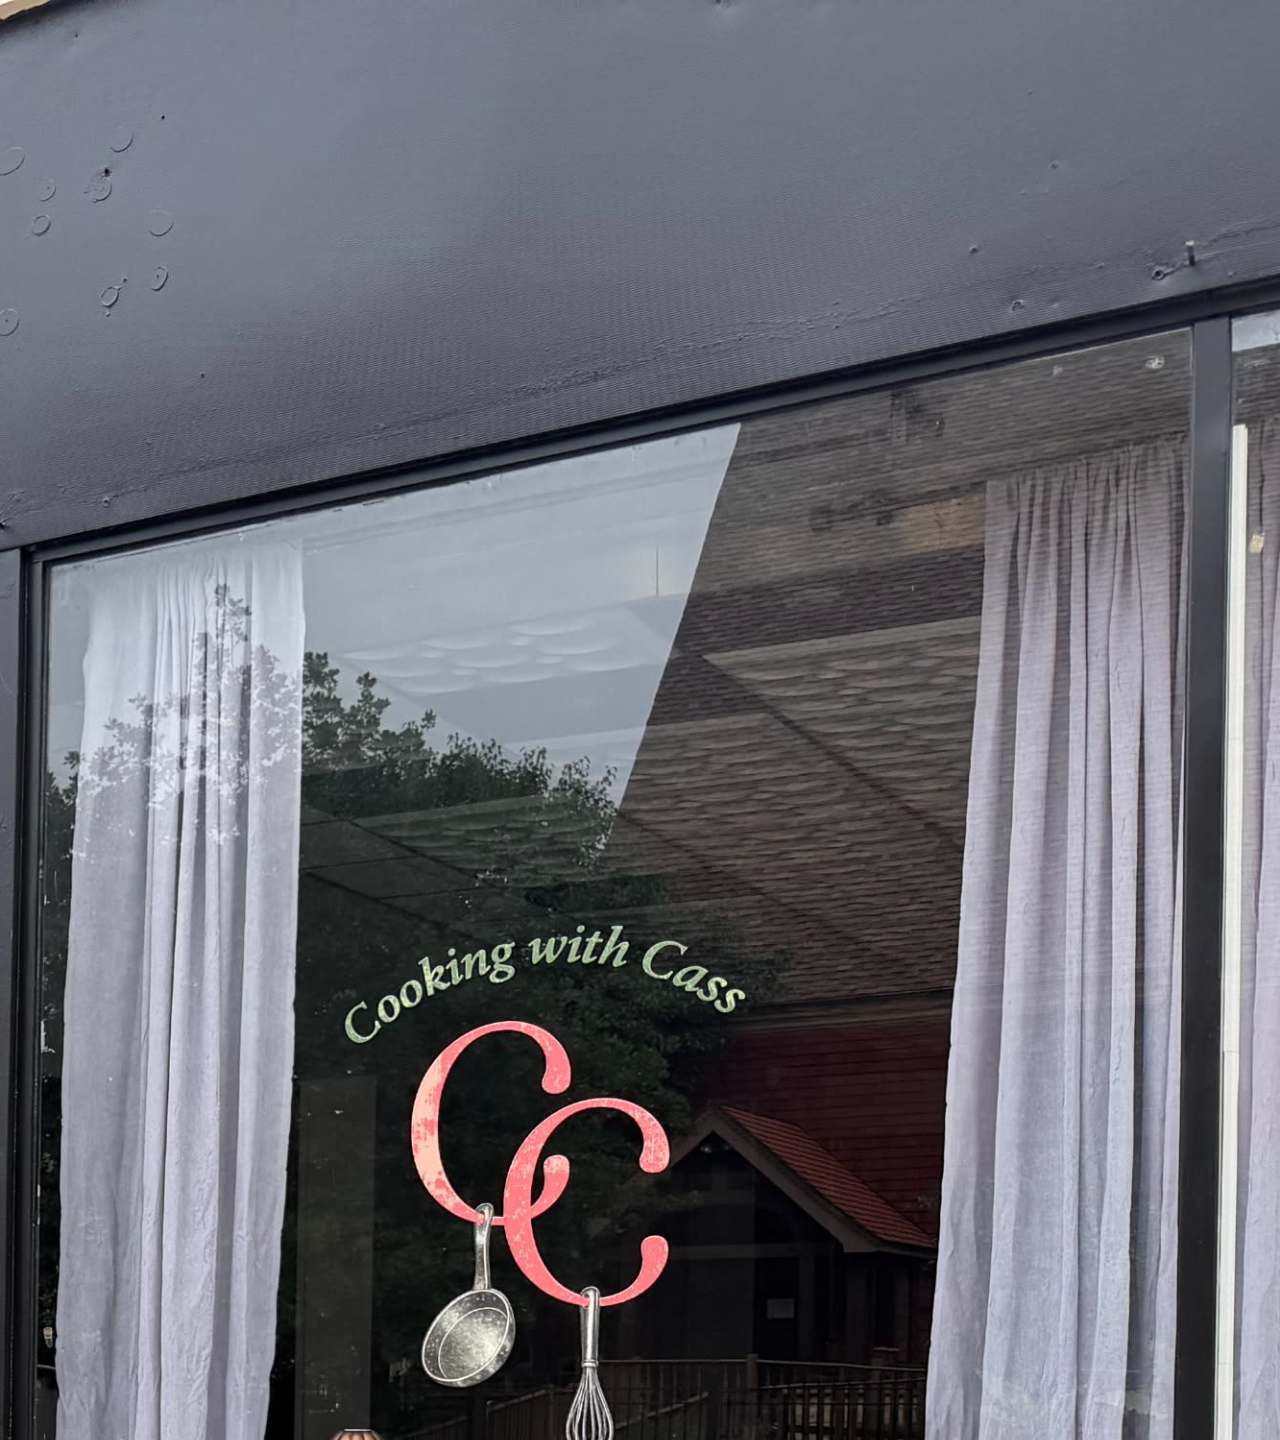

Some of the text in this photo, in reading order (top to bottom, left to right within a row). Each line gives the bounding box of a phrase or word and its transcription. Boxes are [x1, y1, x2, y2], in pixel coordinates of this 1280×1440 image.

[344, 924, 747, 1044] Cooking with Cass
